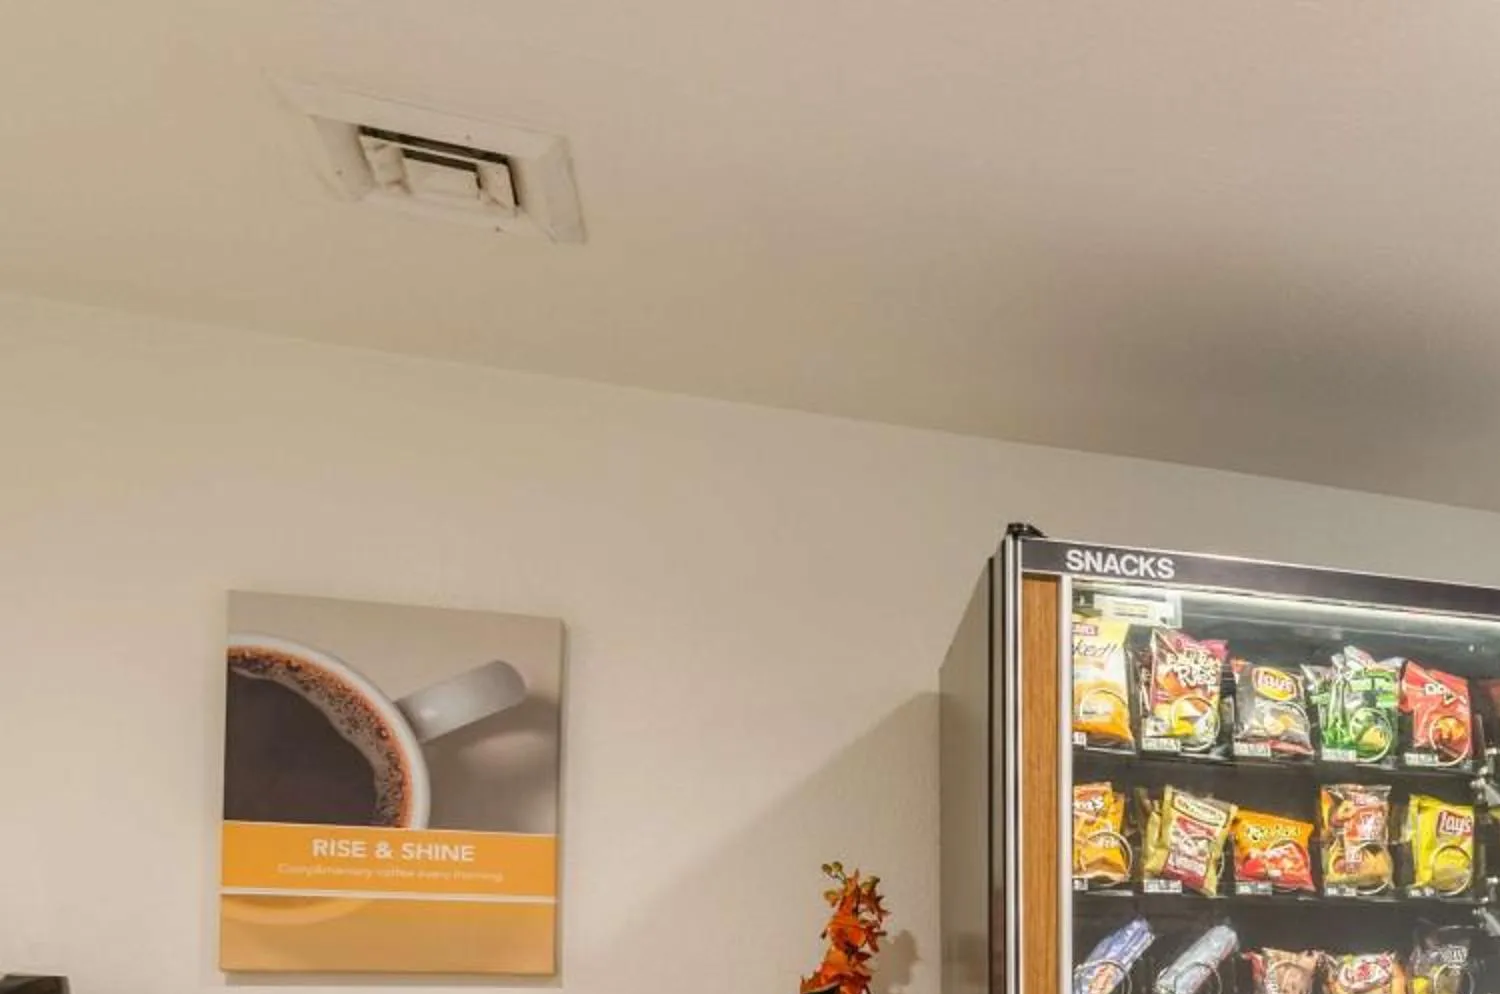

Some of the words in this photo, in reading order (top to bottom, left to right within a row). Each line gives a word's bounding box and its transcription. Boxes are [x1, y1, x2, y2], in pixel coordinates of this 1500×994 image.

[1066, 549, 1175, 579] SNACKS
[312, 838, 367, 858] RISE
[374, 841, 393, 859] &
[401, 842, 476, 862] SHINE
